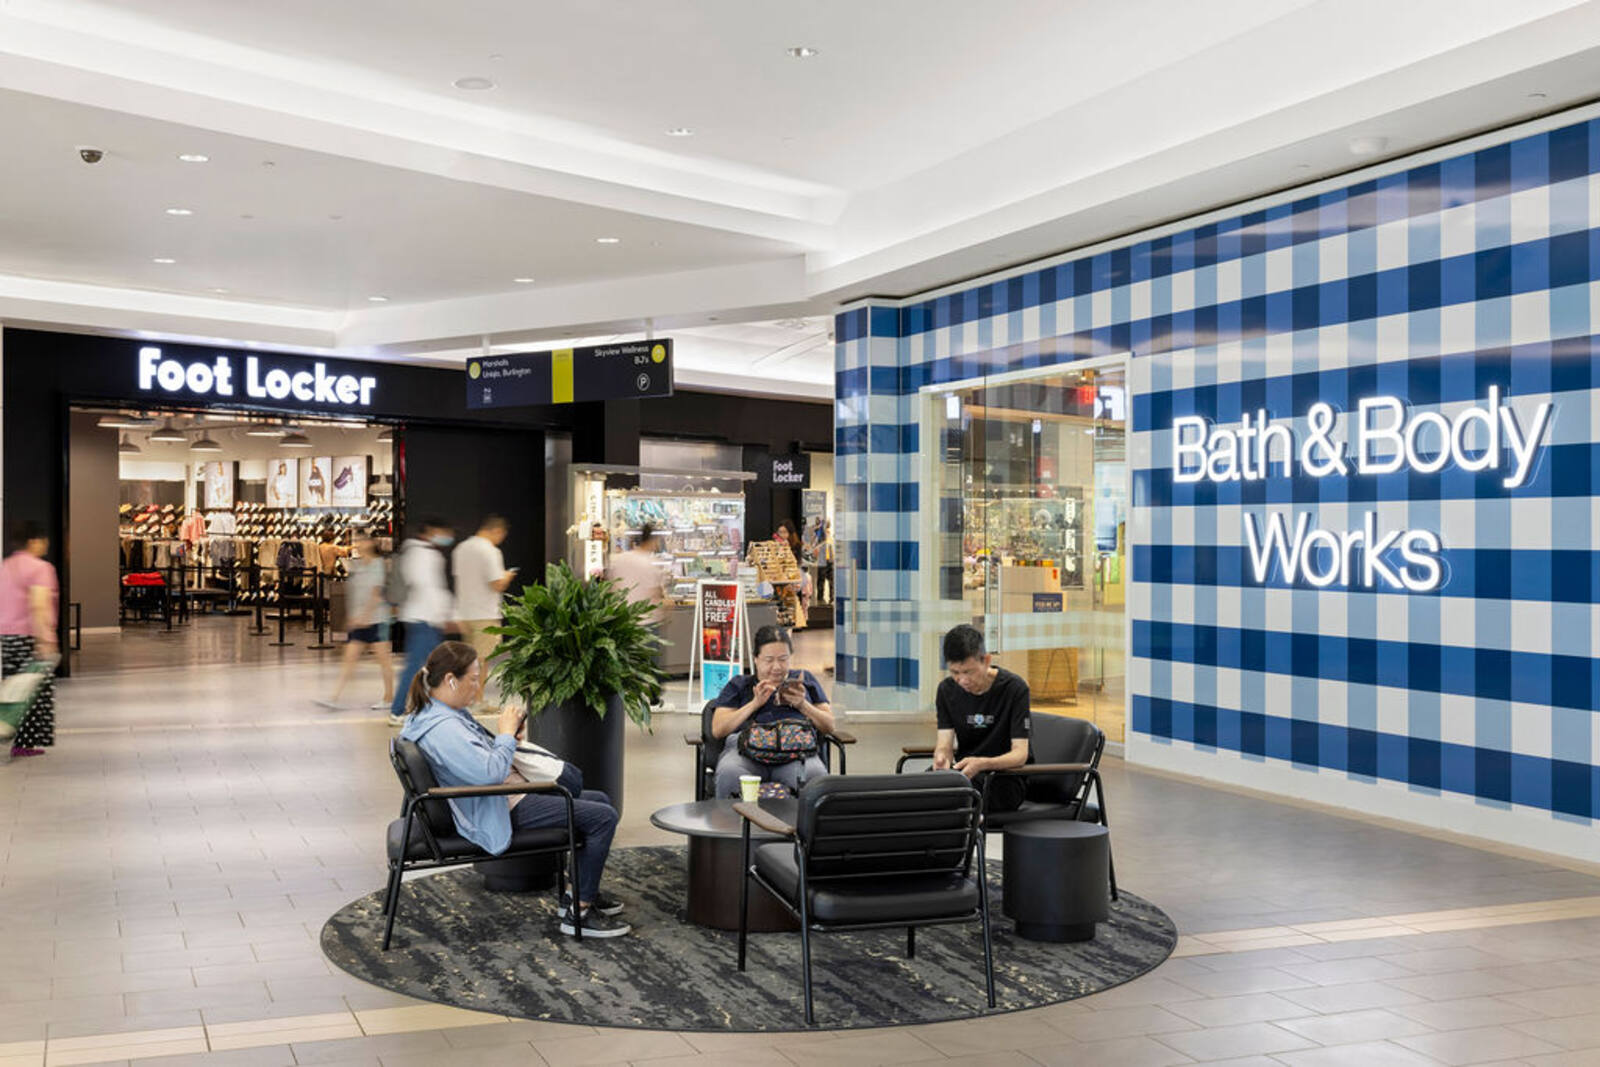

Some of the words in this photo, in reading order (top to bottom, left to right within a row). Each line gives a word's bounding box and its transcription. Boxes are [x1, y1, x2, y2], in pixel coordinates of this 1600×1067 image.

[594, 349, 620, 357] Skyview
[138, 347, 233, 396] Foot
[246, 356, 376, 405] Locker
[502, 368, 532, 378] Burlington
[1173, 408, 1292, 483] Bath
[1302, 402, 1348, 477] &
[1359, 384, 1553, 488] Body
[773, 460, 793, 471] Foot
[773, 471, 804, 482] Locker
[1244, 511, 1441, 591] Works
[704, 590, 717, 598] ALL
[704, 599, 736, 607] CANDLES
[705, 612, 728, 622] FREE
